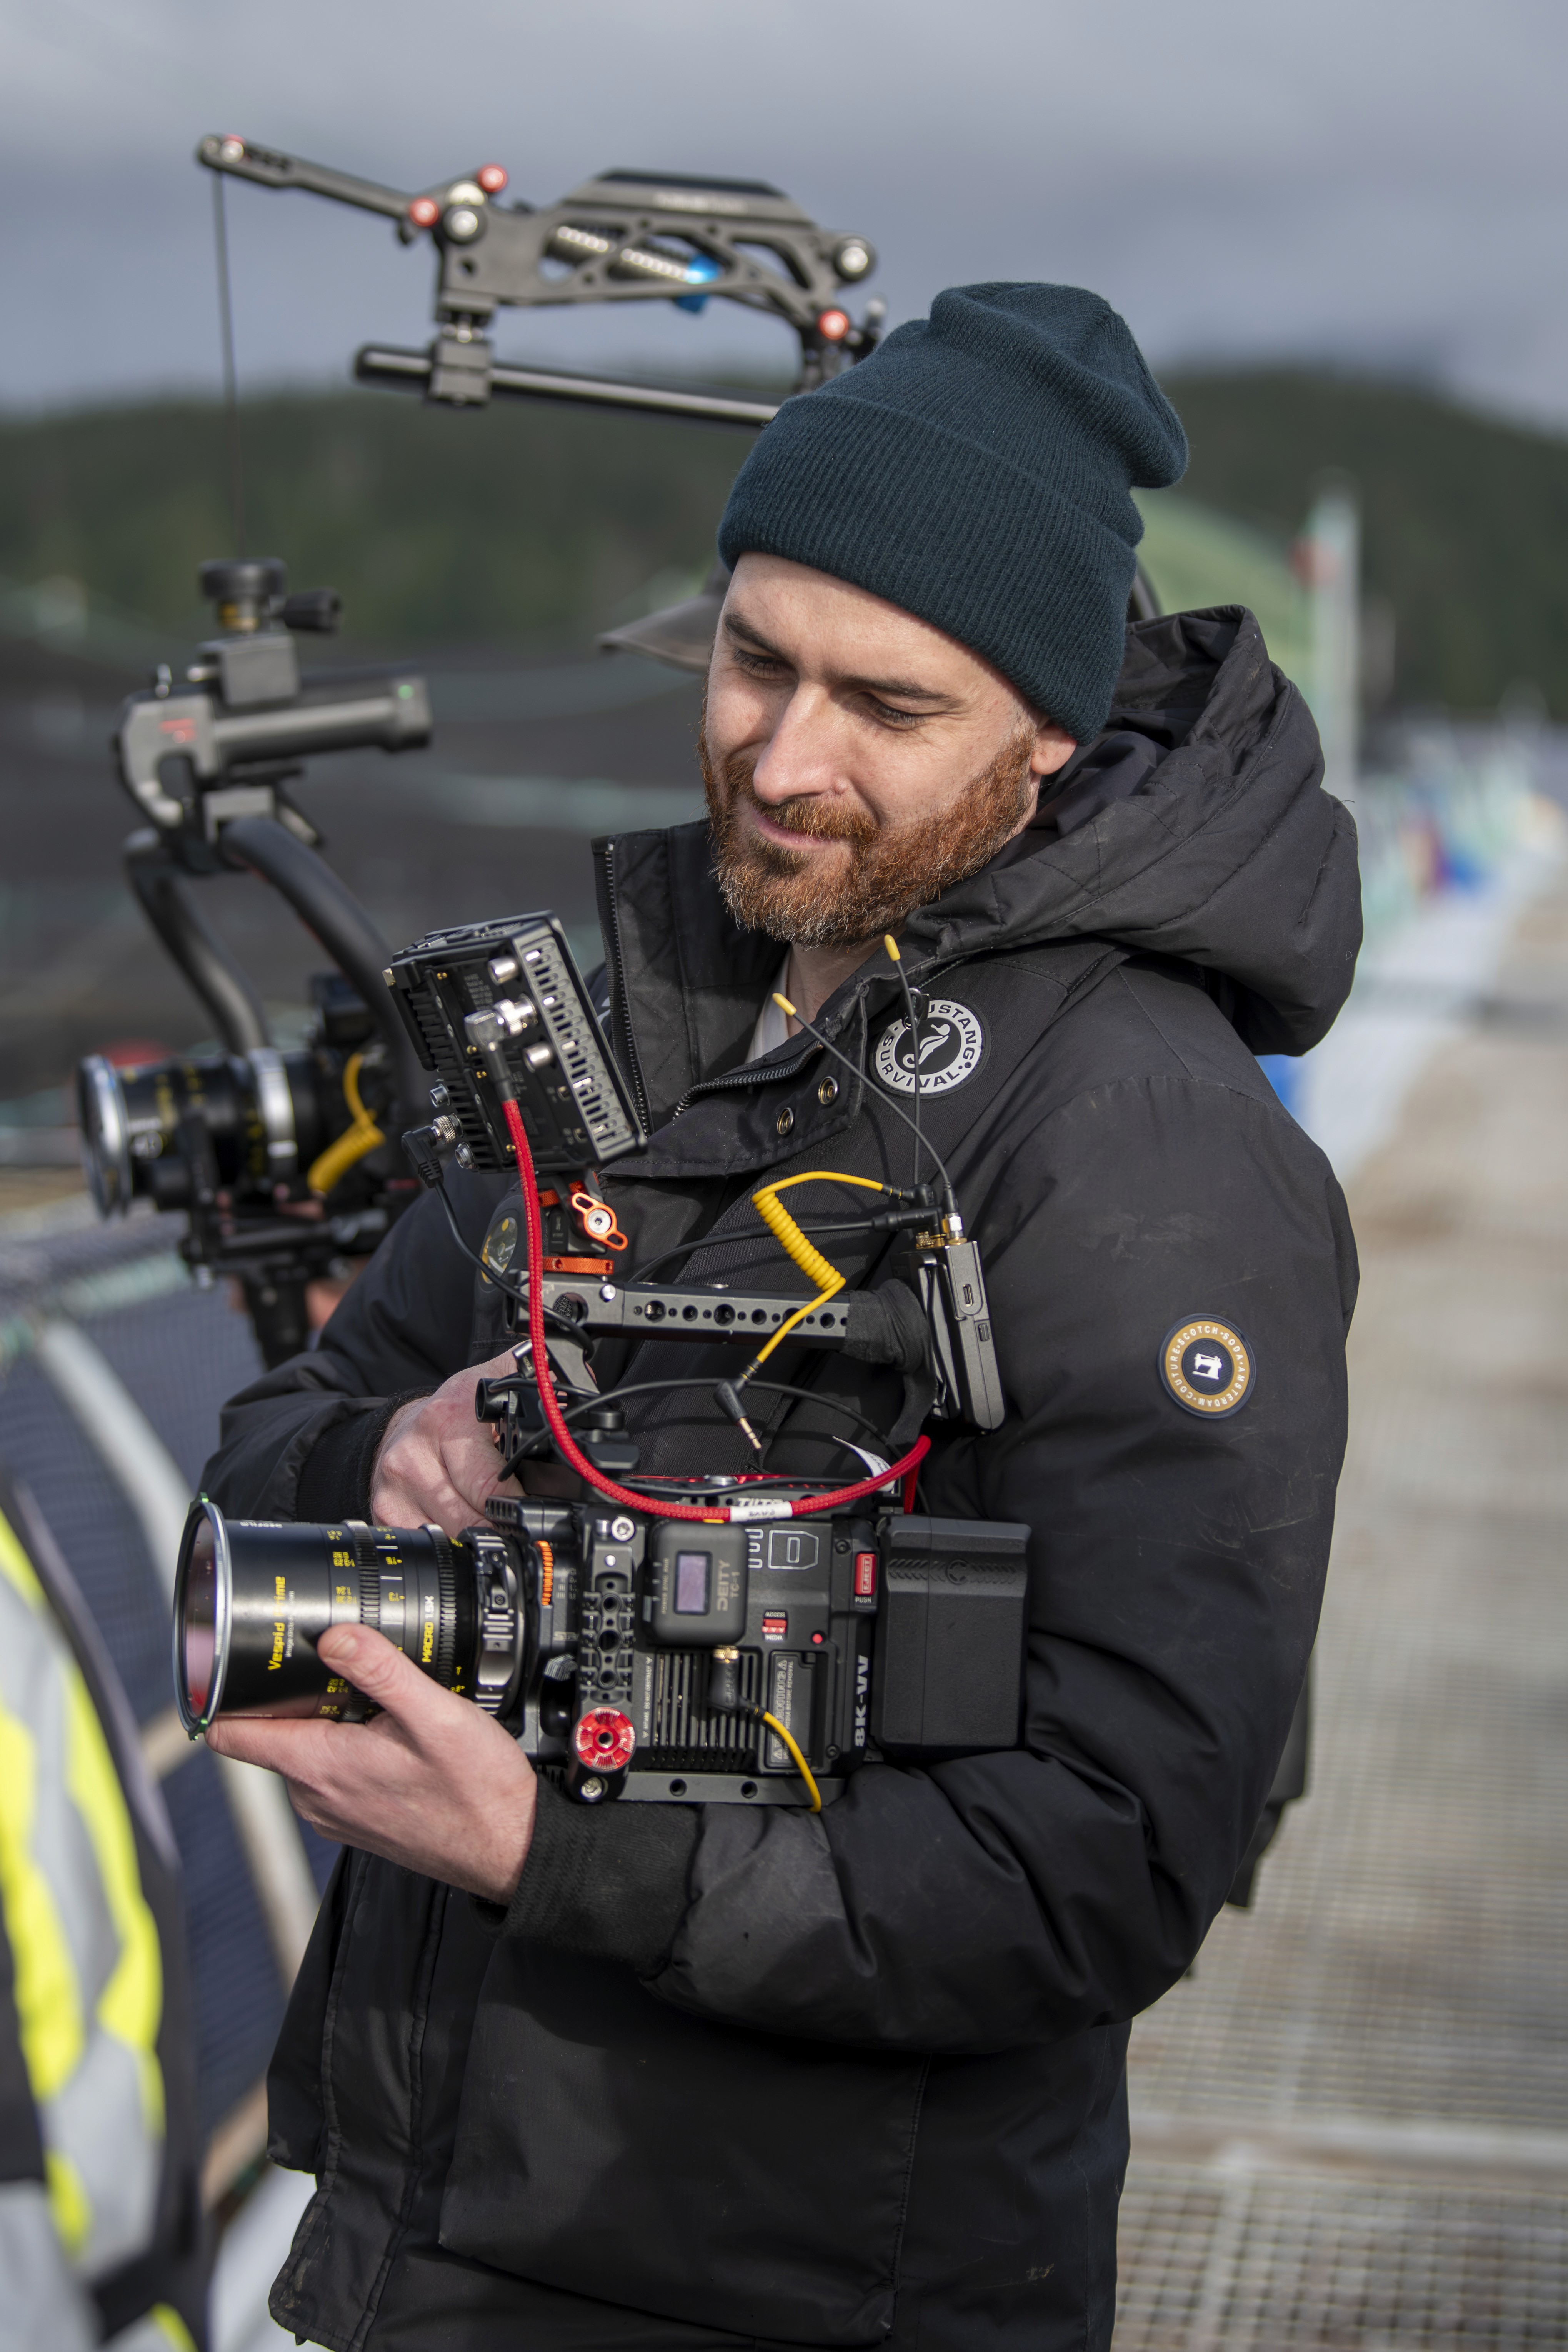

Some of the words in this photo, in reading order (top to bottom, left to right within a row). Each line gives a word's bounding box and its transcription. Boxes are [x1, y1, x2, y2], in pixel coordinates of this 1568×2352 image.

[928, 1004, 977, 1060] USTANG
[880, 1035, 960, 1088] SURVIVAL
[1177, 1325, 1218, 1346] SCOTCH
[1222, 1333, 1243, 1361] SODA
[1170, 1348, 1193, 1399] COUTURE
[1198, 1366, 1245, 1407] AMSTERDAM
[273, 1576, 286, 1617] Prime
[716, 1559, 730, 1612] DEITY
[730, 1571, 740, 1599] TC-1
[863, 1558, 871, 1593] EJECT
[424, 1596, 435, 1619] 1.5X
[267, 1622, 285, 1671] Vespid
[421, 1621, 434, 1663] MACRO
[854, 1655, 869, 1747] 8K-VV
